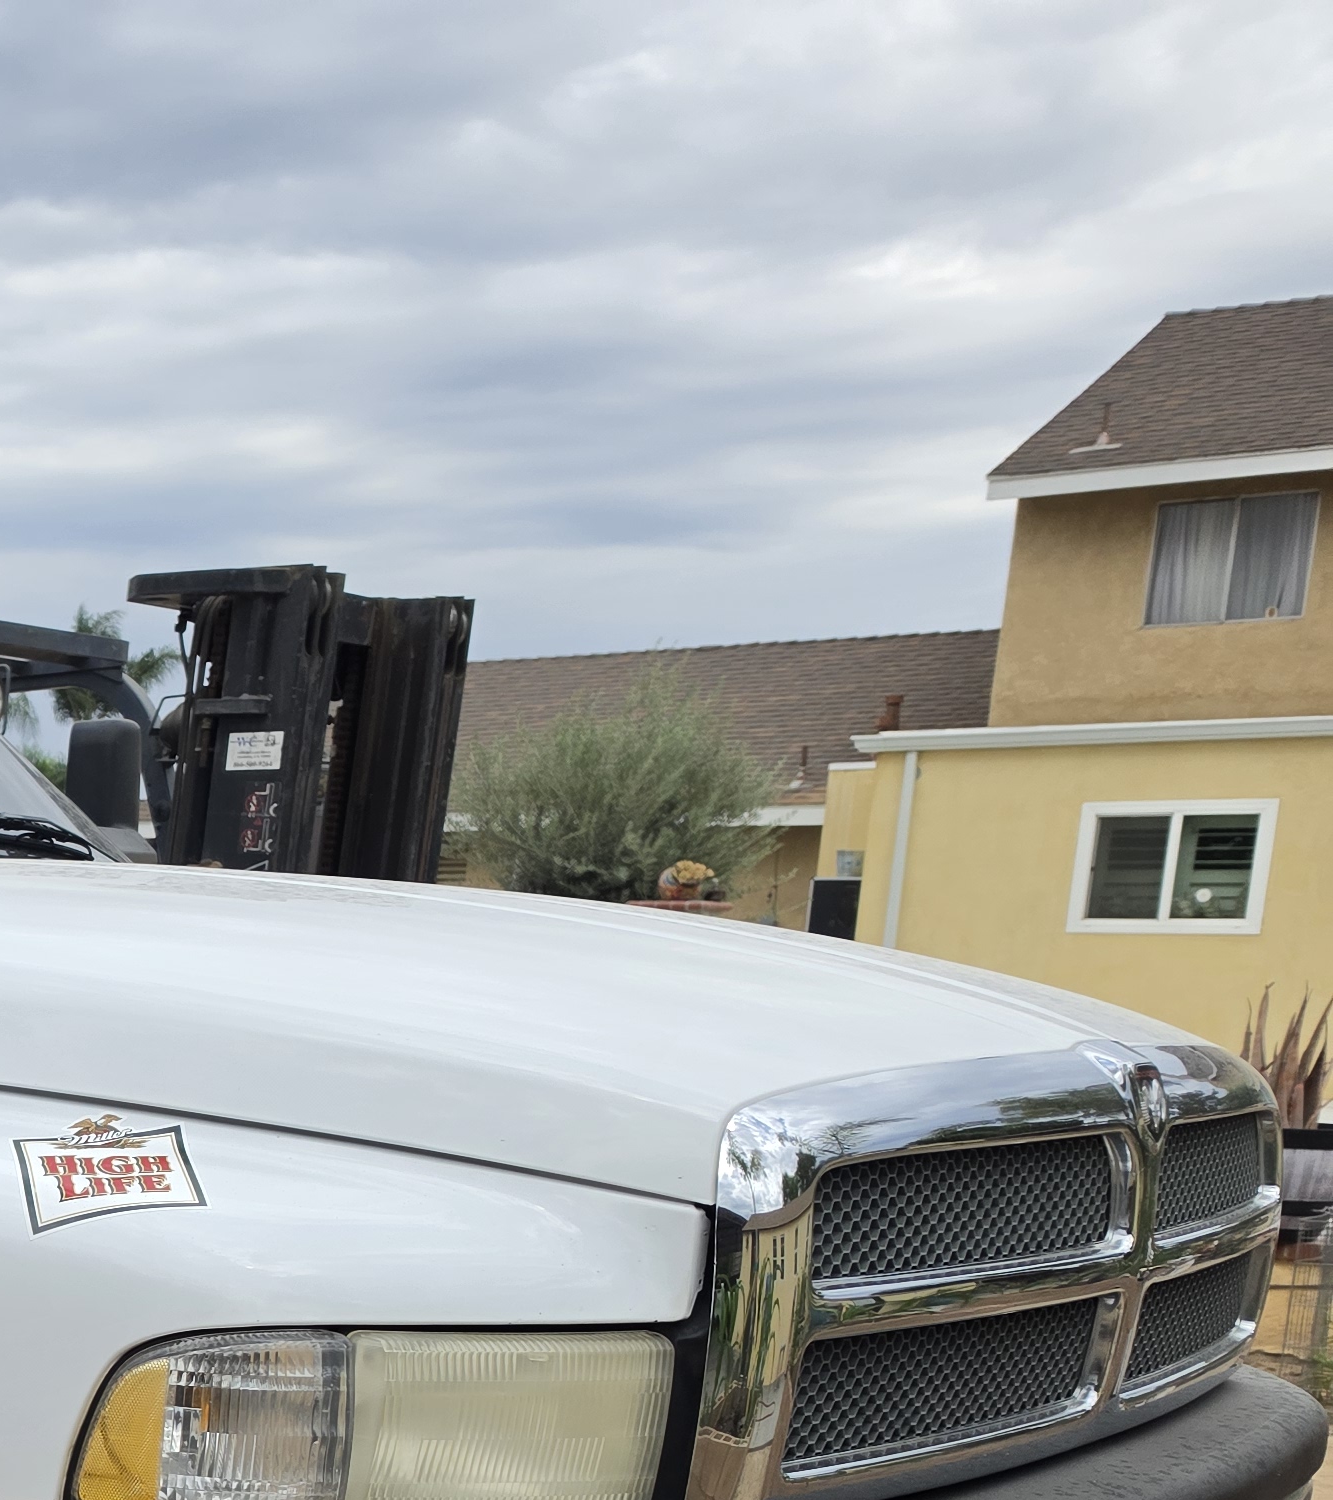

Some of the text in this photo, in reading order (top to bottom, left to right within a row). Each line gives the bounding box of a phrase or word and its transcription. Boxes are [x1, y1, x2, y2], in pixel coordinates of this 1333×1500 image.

[58, 1128, 132, 1146] Miller
[38, 1155, 175, 1176] HIGH
[55, 1174, 171, 1203] LIFE
